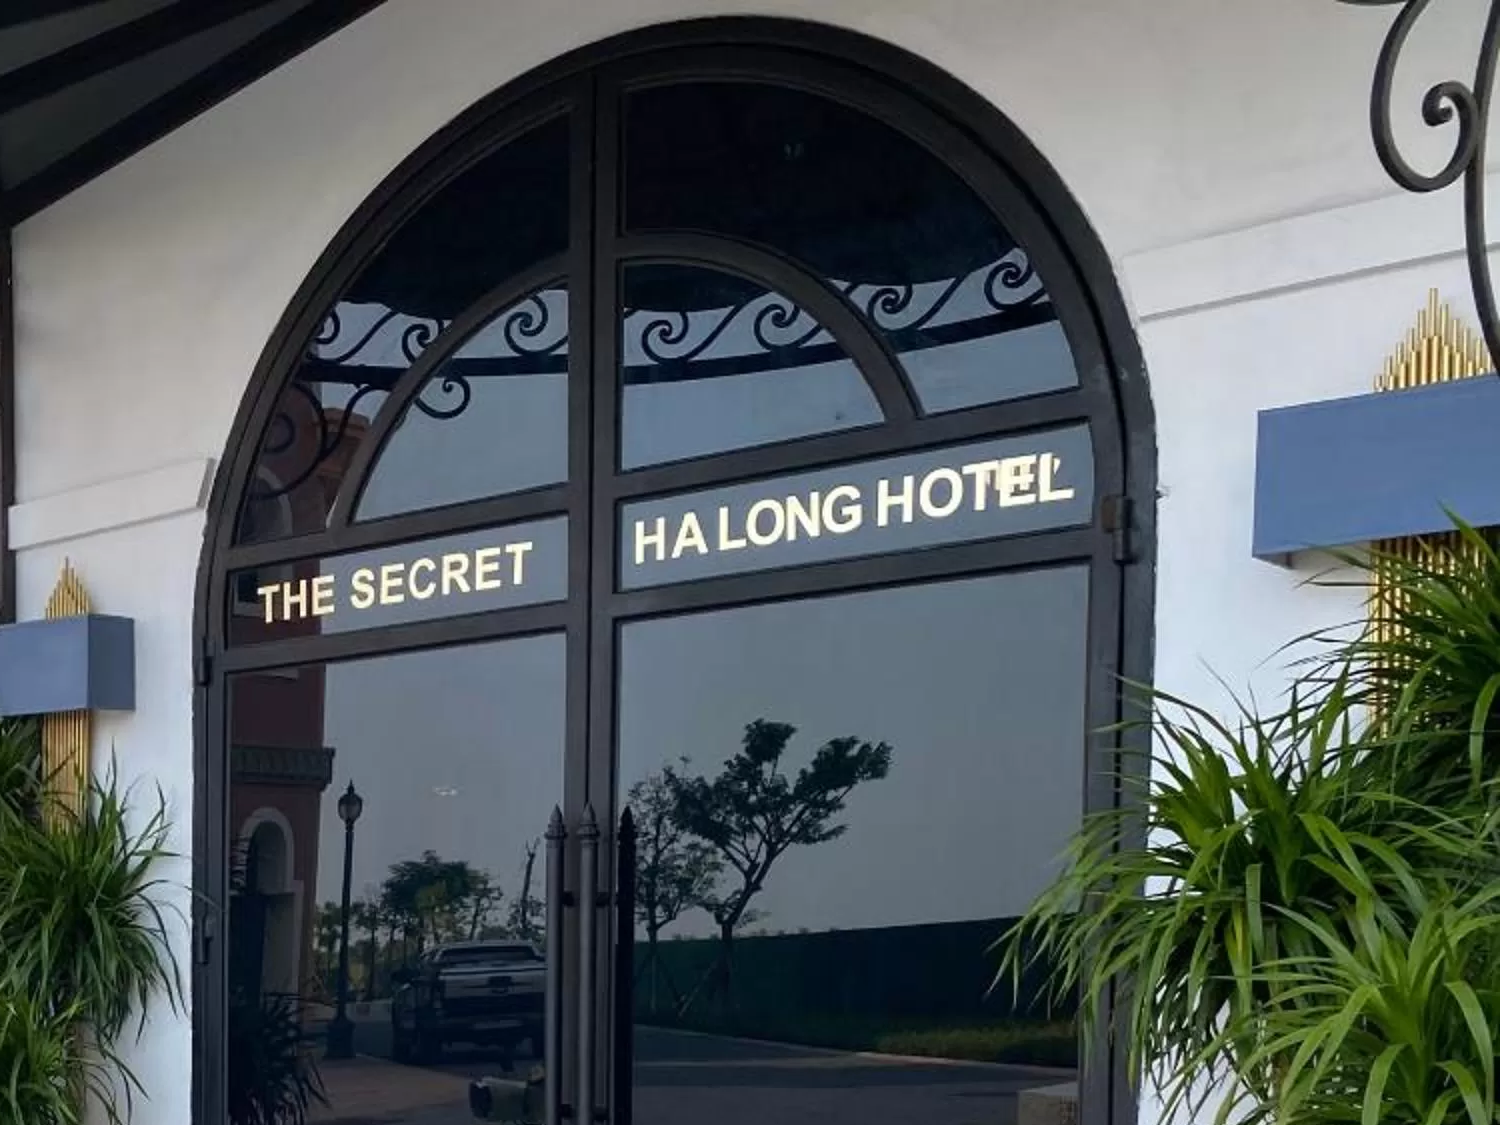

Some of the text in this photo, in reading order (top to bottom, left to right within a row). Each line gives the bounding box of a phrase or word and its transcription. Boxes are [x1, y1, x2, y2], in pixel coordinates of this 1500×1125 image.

[876, 452, 1075, 527] HOTEL
[257, 541, 533, 624] THE SECRET
